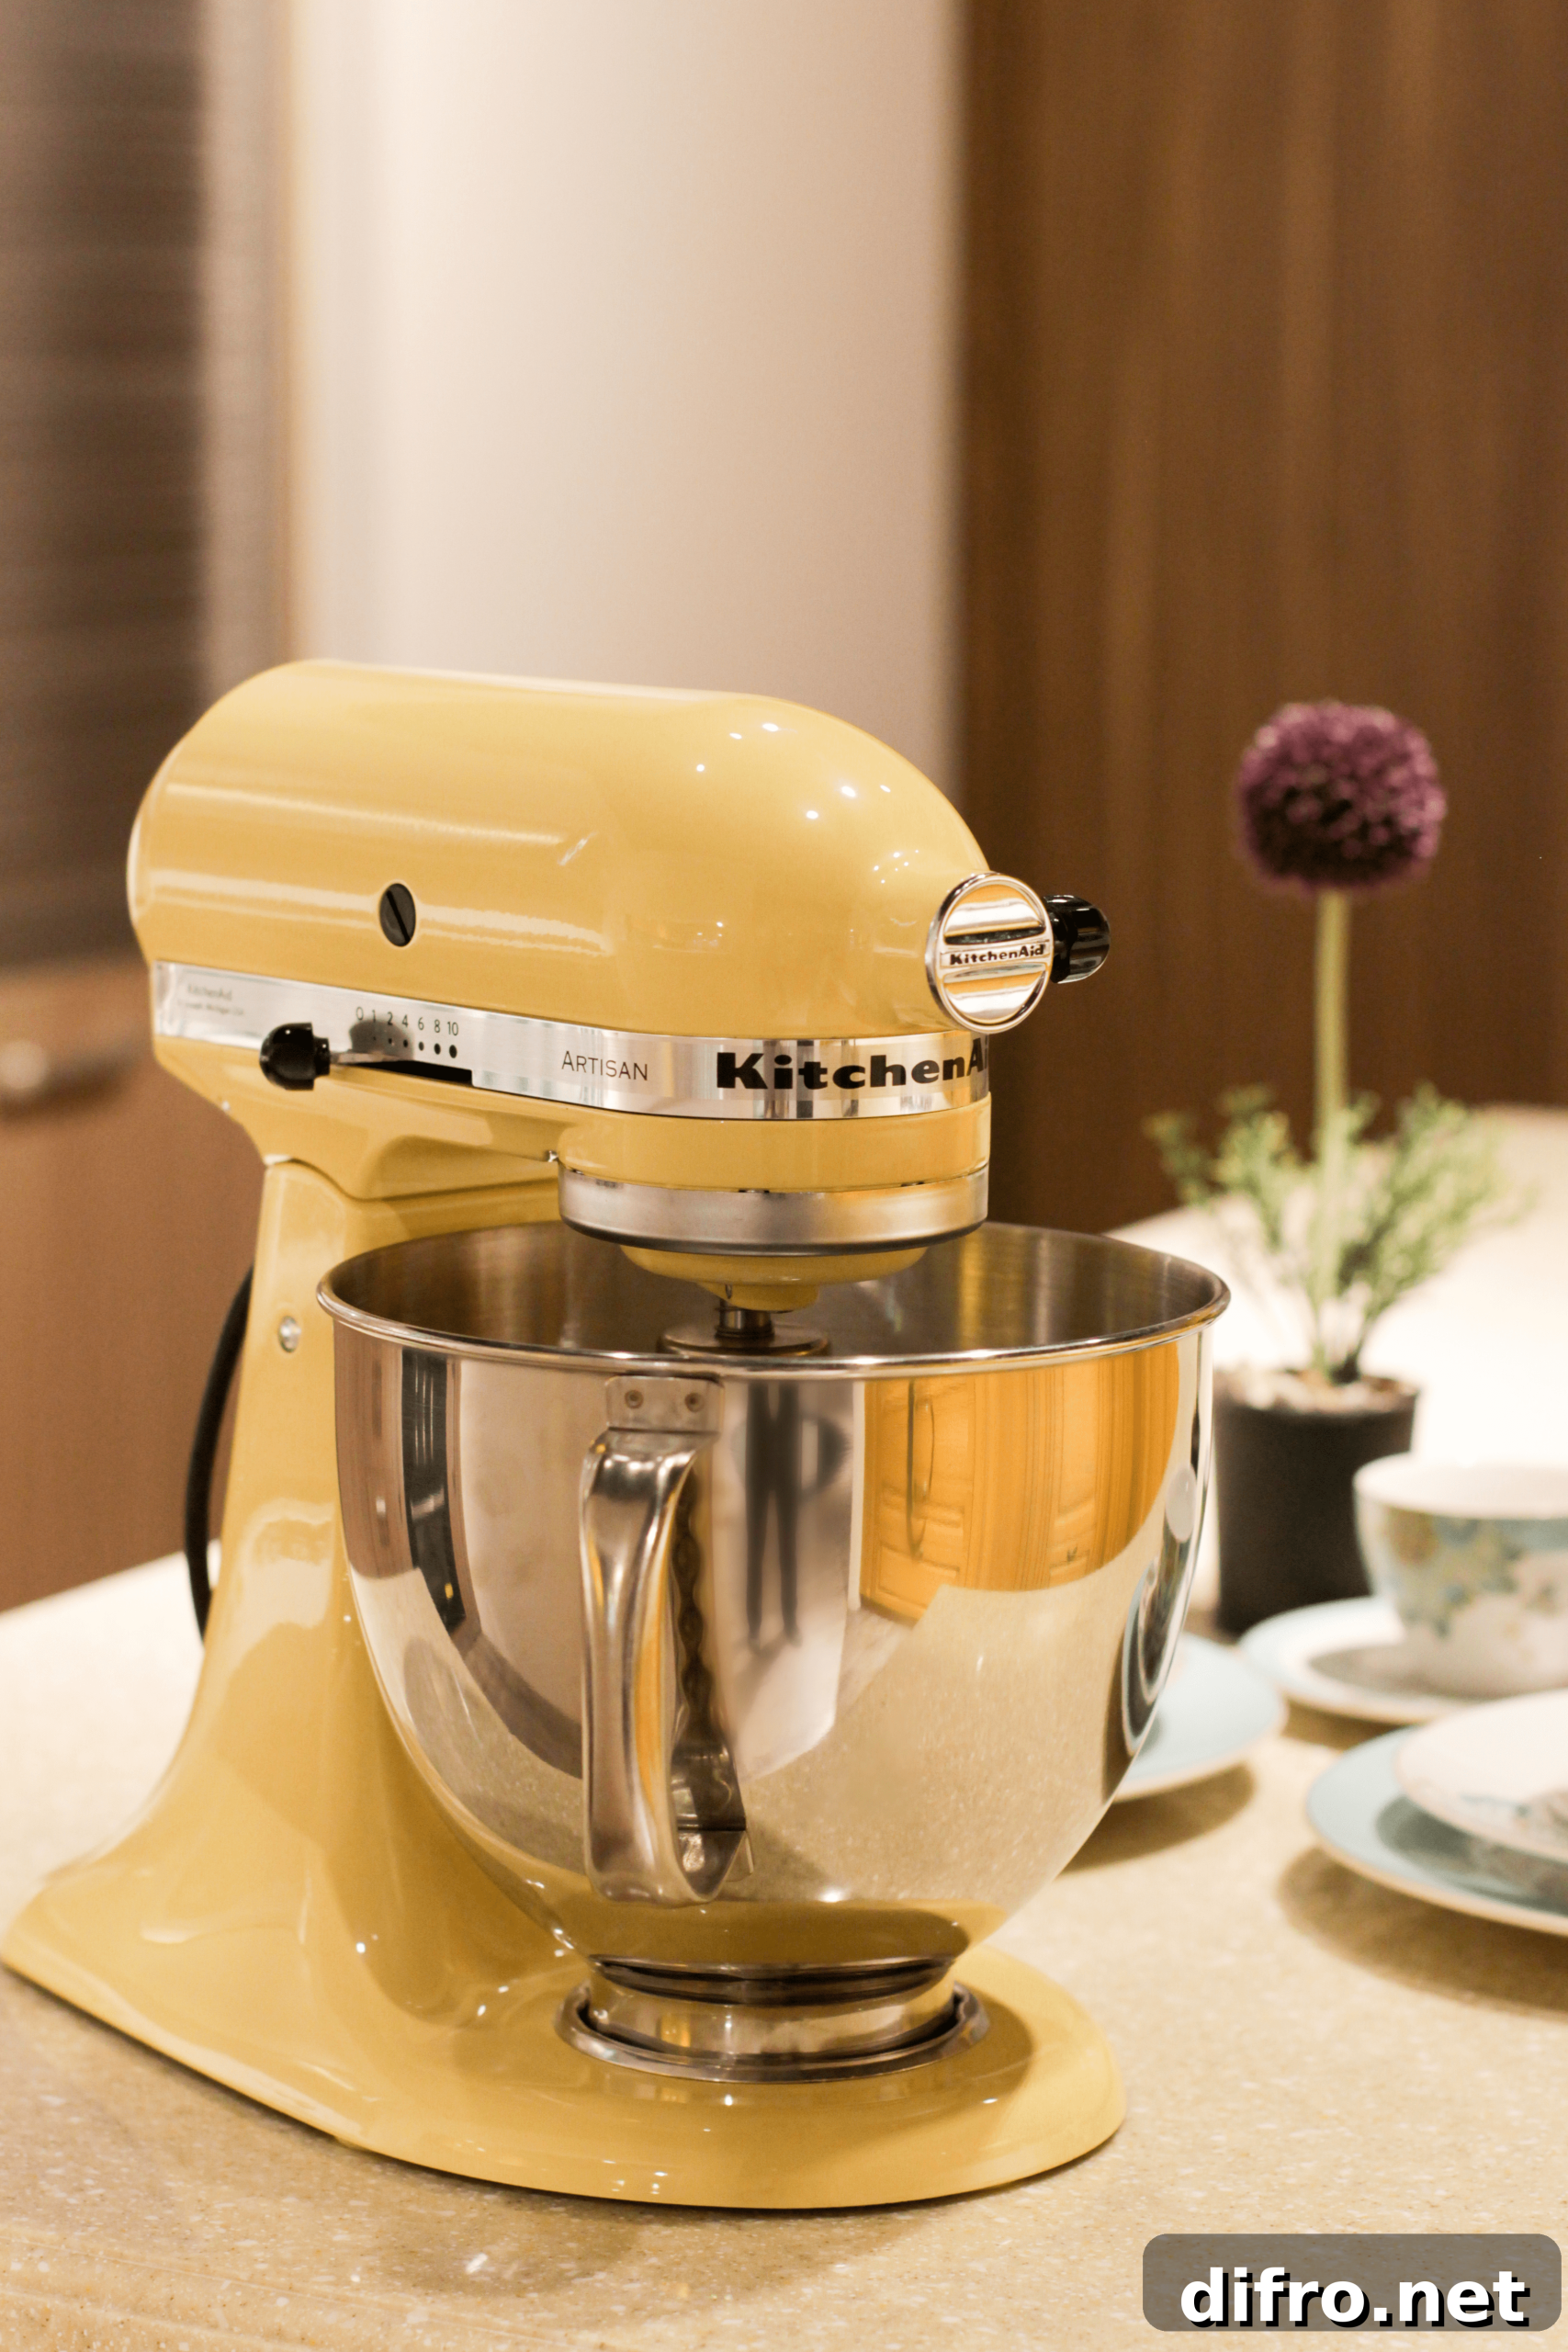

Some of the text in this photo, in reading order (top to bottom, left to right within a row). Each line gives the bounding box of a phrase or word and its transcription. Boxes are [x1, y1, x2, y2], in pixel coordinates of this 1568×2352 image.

[950, 944, 1045, 965] KitchenAid
[355, 1006, 459, 1036] 0 1 2 4 6 8 10
